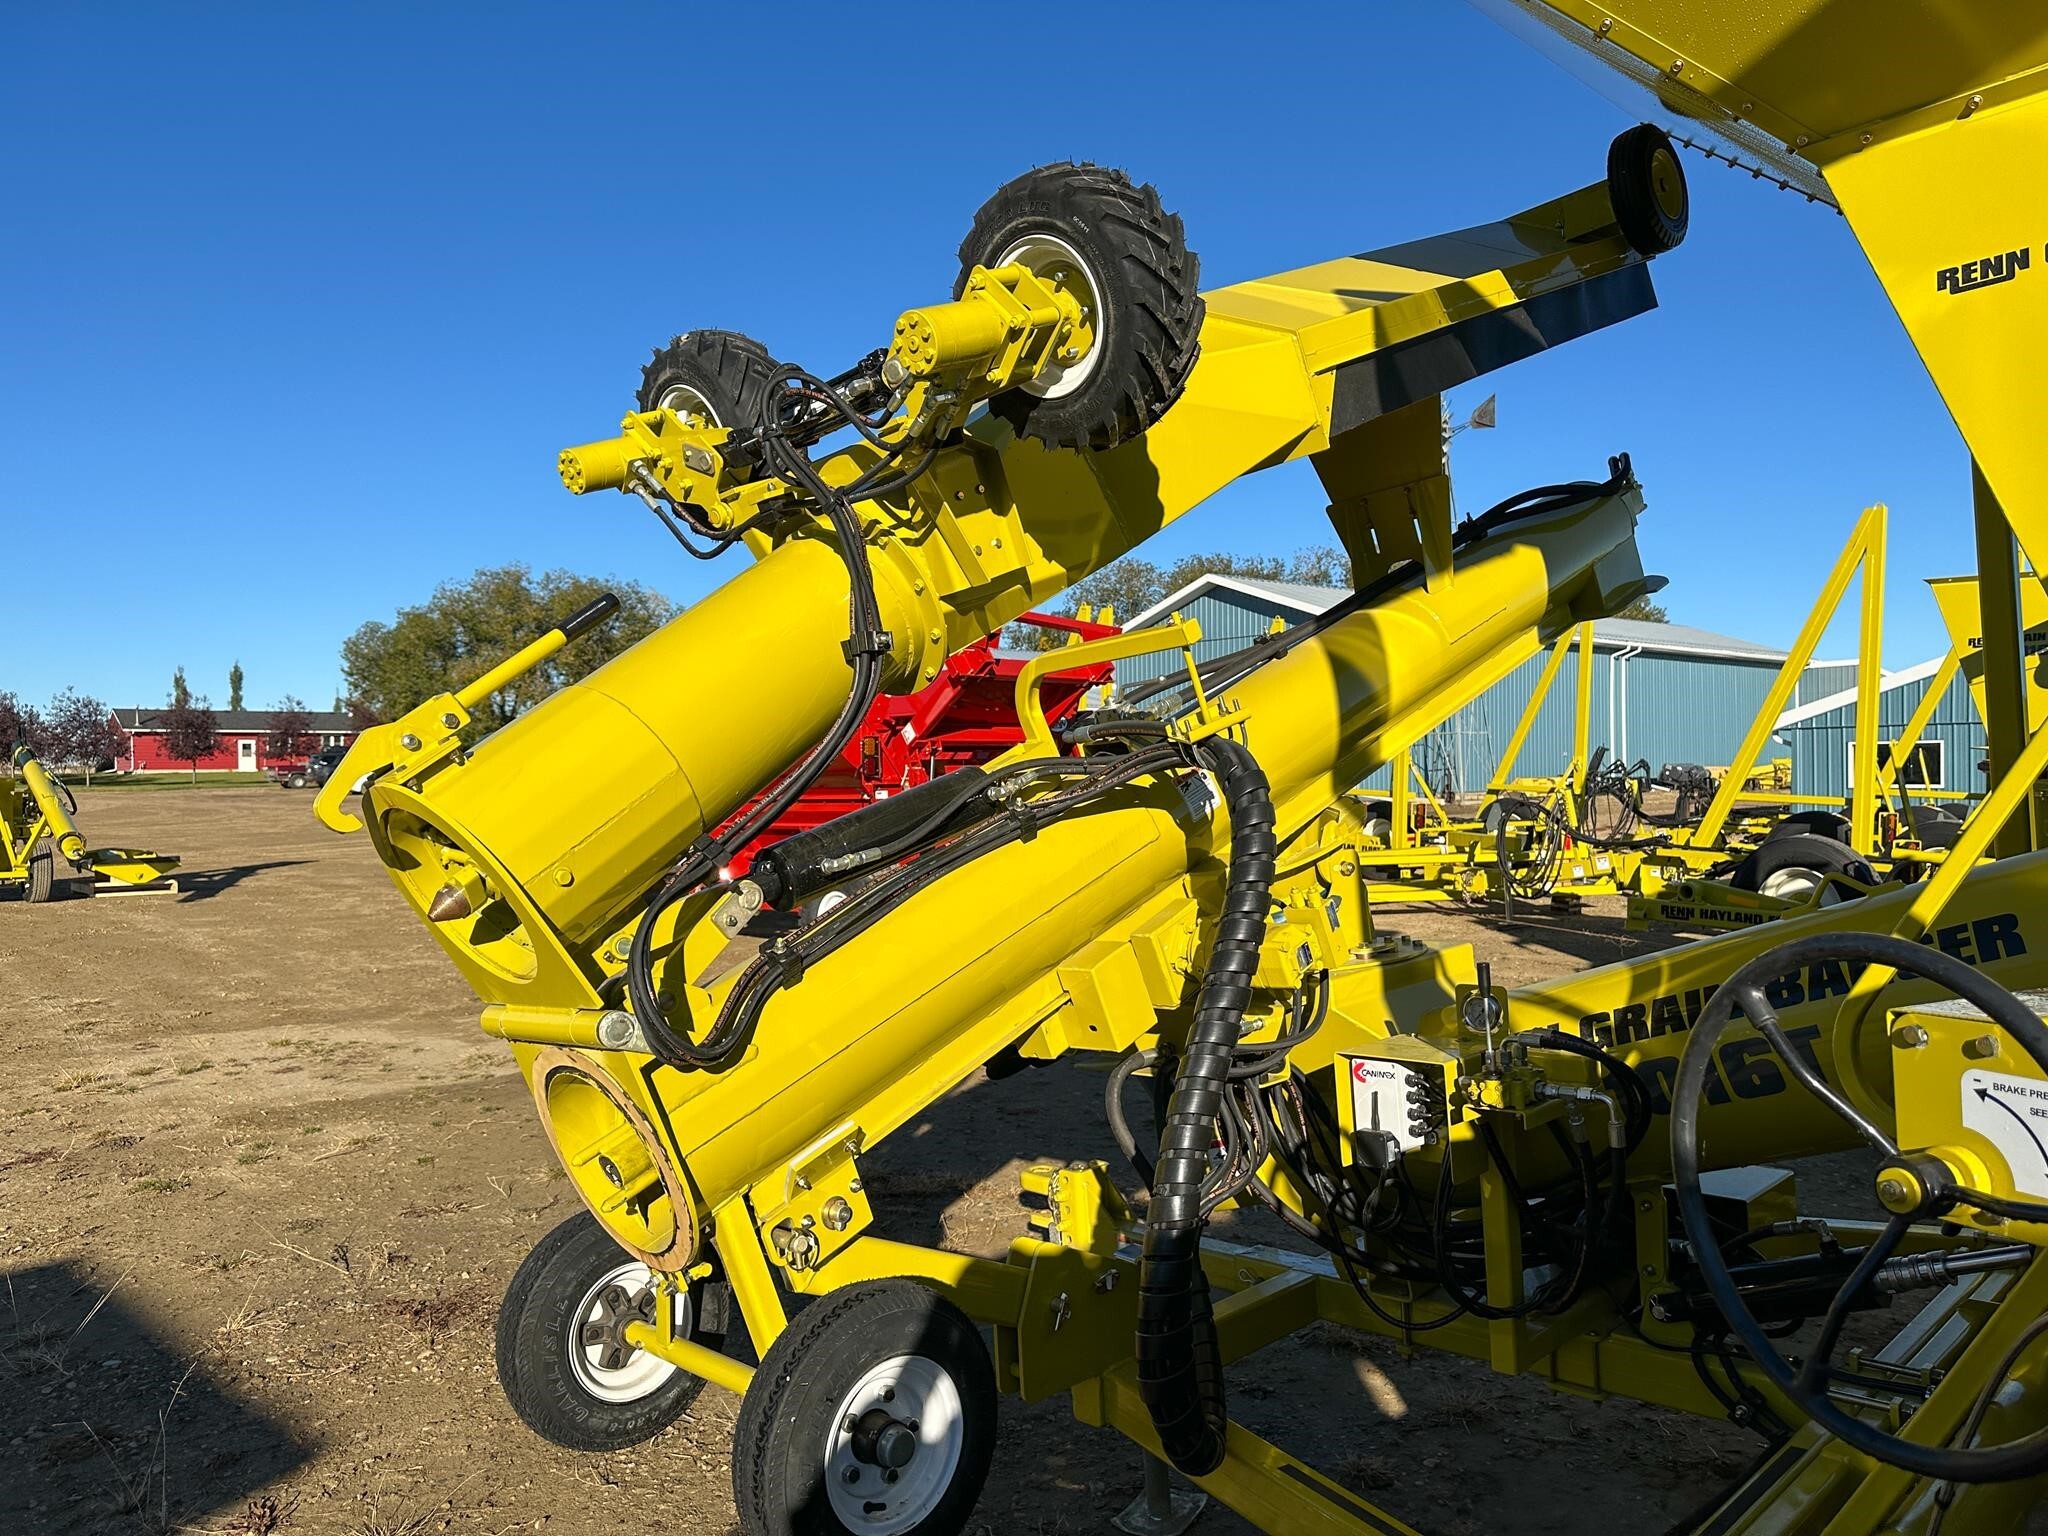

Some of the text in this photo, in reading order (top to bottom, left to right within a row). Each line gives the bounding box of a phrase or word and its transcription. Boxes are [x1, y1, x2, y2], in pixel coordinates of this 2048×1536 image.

[1936, 247, 2030, 295] RENN
[1660, 904, 1695, 920] RENN
[1699, 908, 1763, 925] HAYLAND
[1579, 983, 1746, 1049] GRAI
[1361, 1068, 1396, 1080] CANIMEX
[1992, 1082, 2028, 1097] BRAKE
